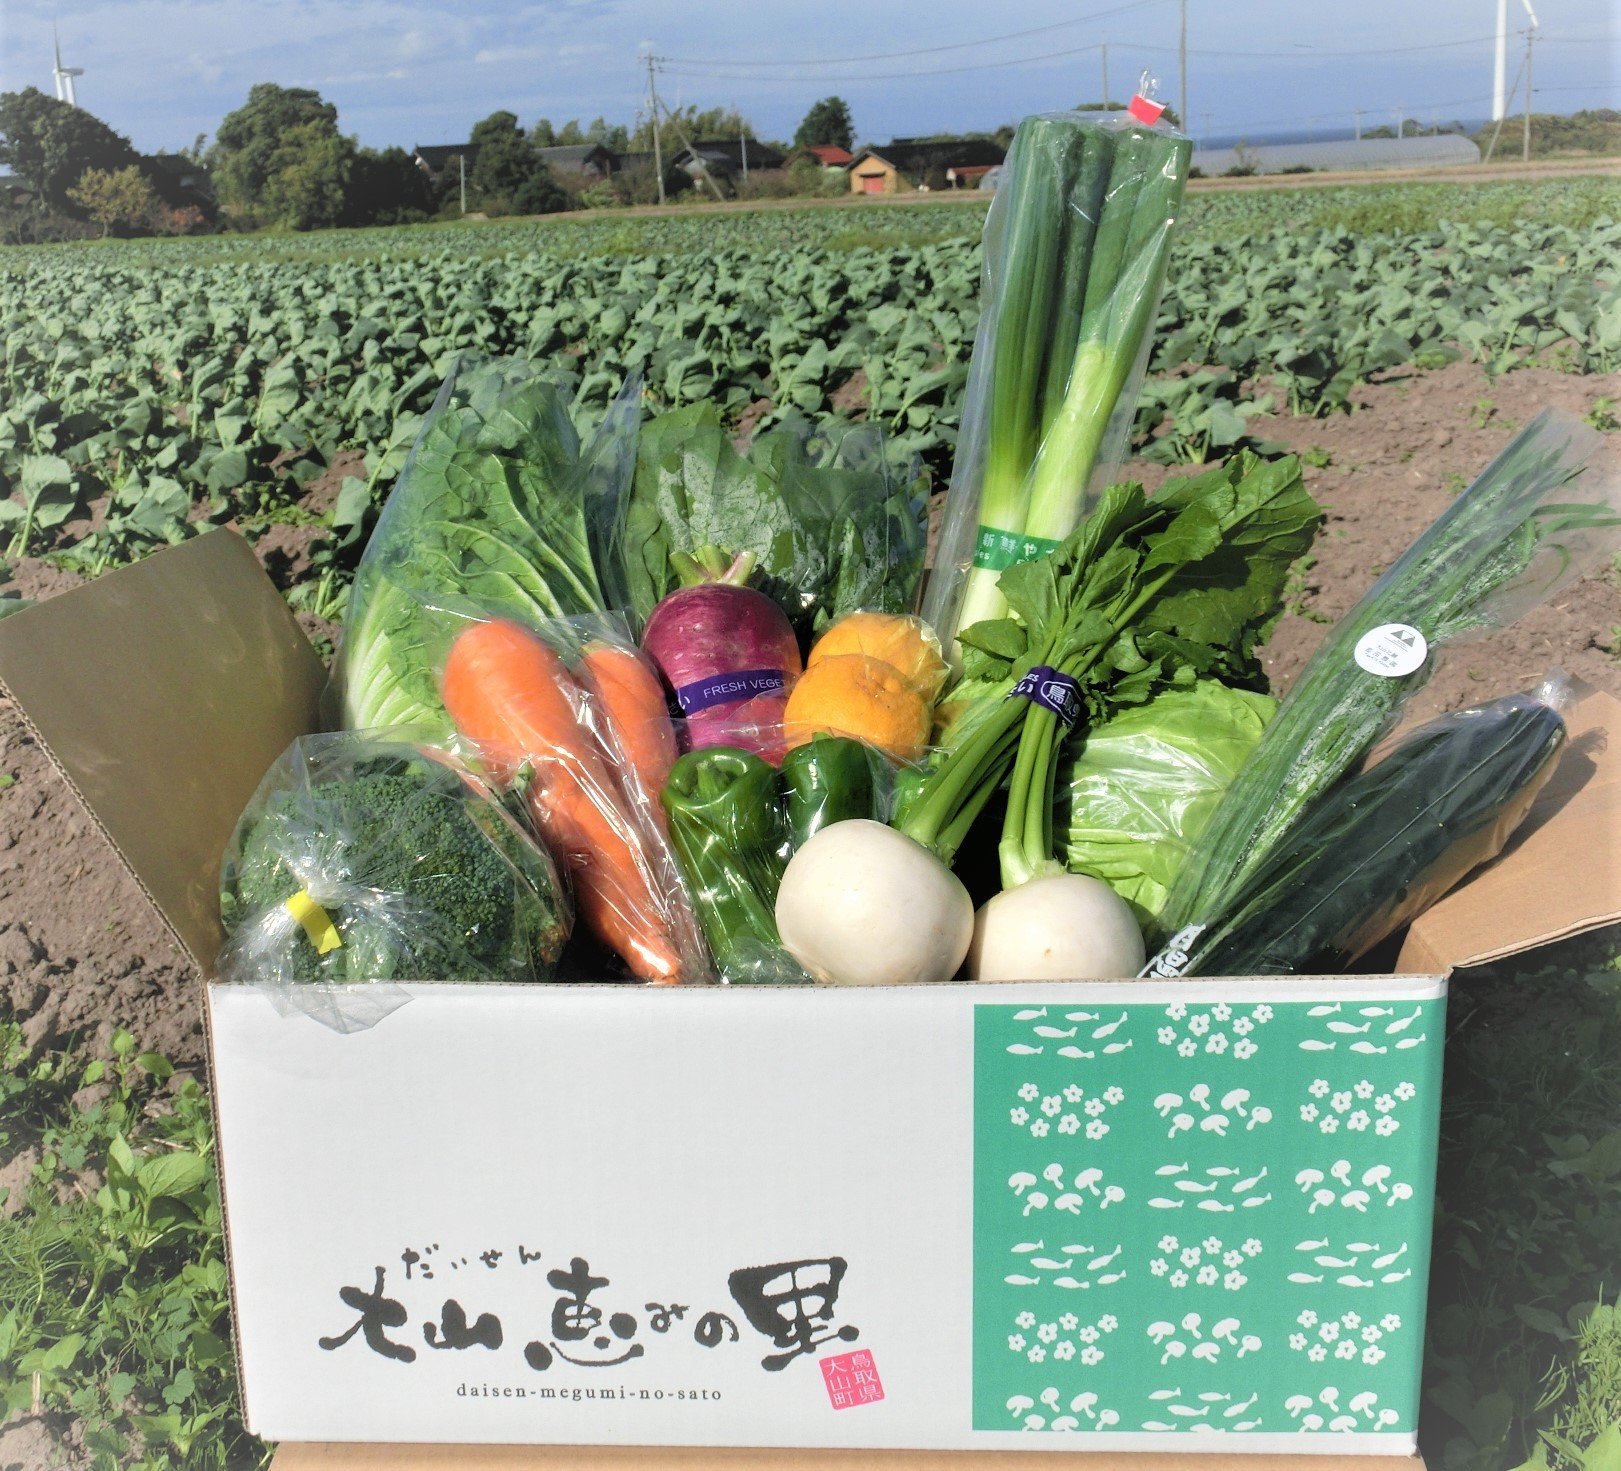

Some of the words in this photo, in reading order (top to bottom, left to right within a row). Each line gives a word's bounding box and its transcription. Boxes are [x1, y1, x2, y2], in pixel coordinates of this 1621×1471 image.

[703, 681, 747, 699] FRESH
[401, 1244, 542, 1280] だいせん
[456, 1383, 722, 1402] daisen-megumi-no-sato
[824, 1359, 854, 1406] 大山町
[851, 1353, 881, 1402] 鳥取県
